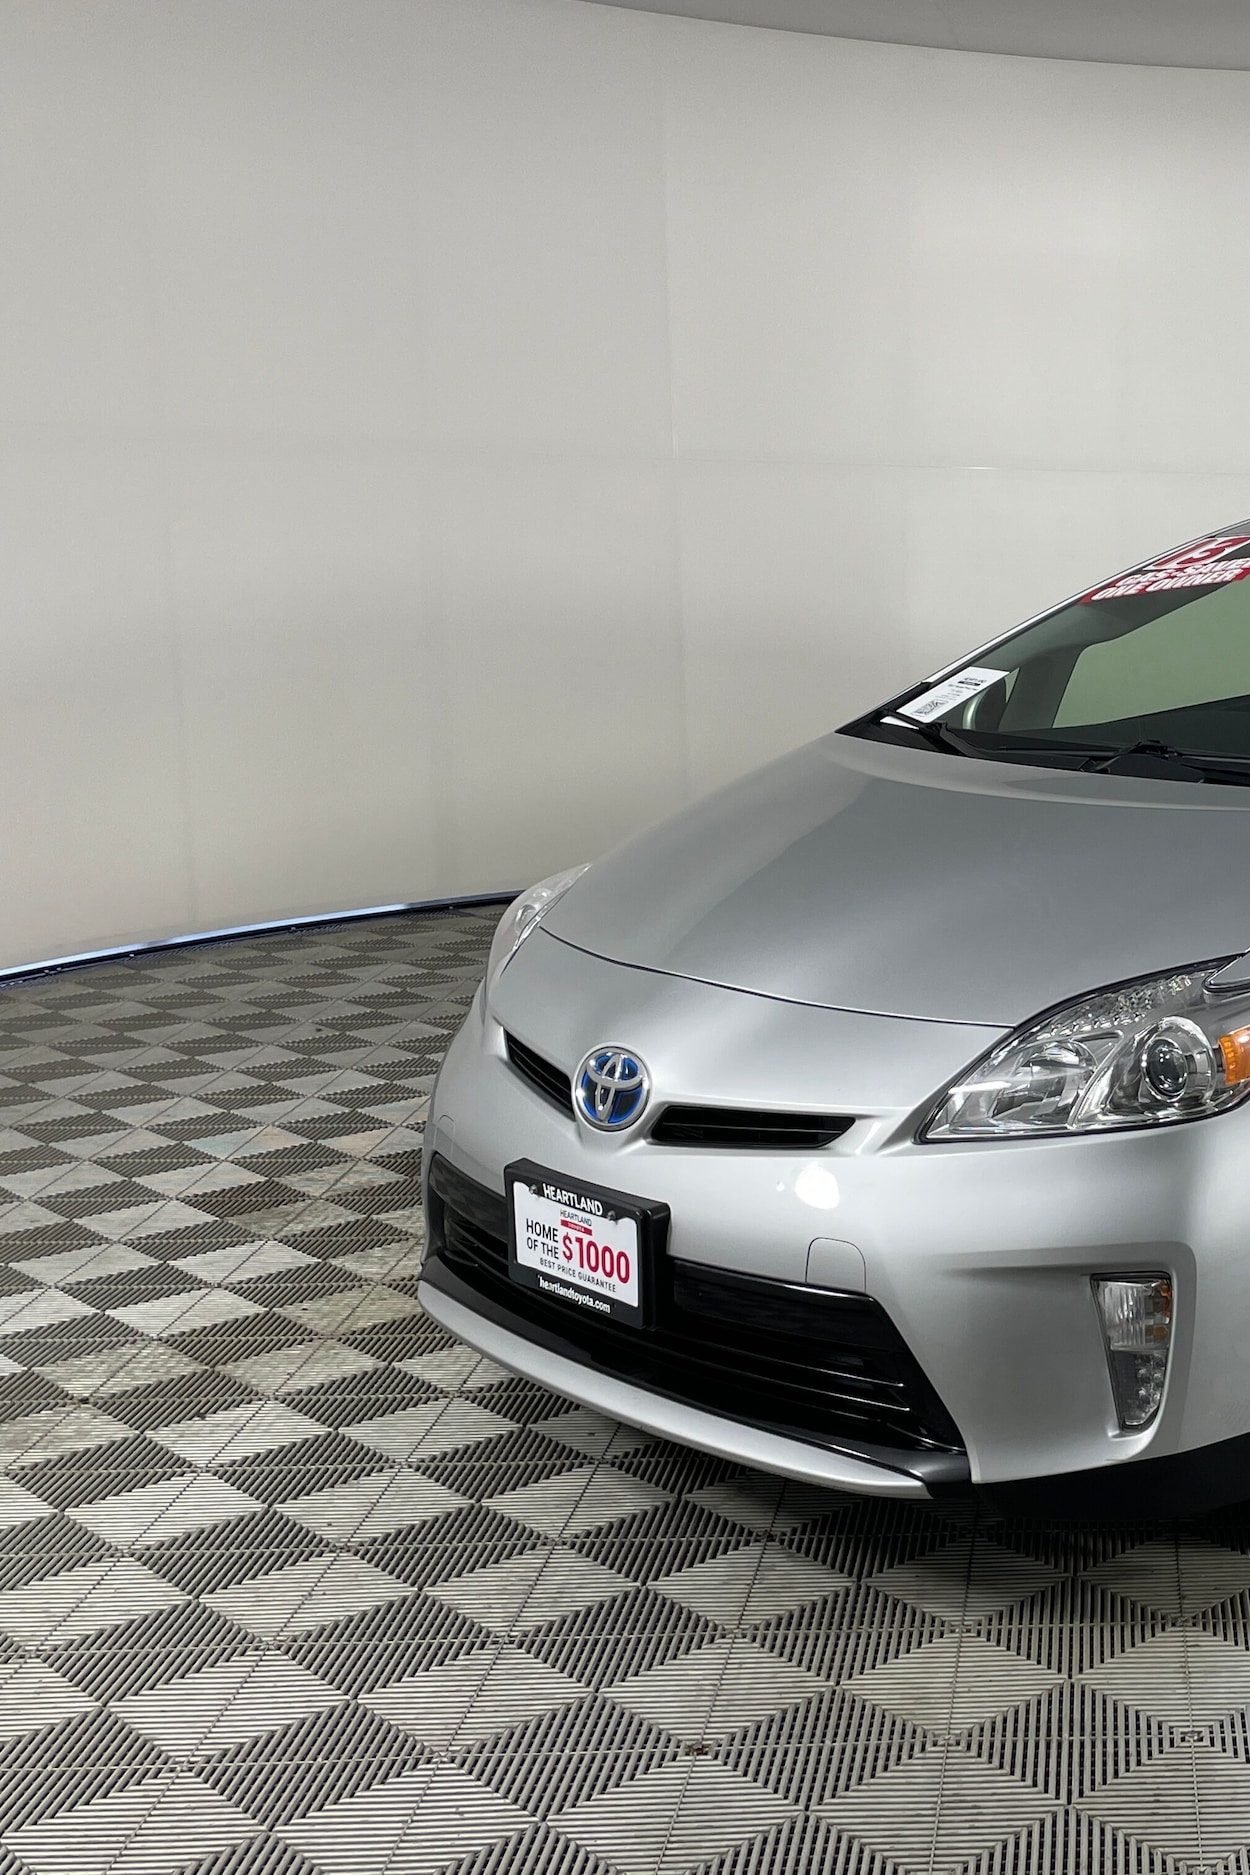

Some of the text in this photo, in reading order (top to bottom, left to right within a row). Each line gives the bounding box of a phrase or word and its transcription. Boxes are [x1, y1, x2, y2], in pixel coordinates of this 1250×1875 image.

[1091, 568, 1244, 601] ONE OWNER
[542, 1183, 603, 1216] HEARTLAND
[526, 1218, 559, 1243] HOME
[560, 1209, 592, 1227] HEARTLAND
[526, 1237, 559, 1260] OF THE
[562, 1232, 630, 1284] $1000
[539, 1258, 616, 1293] BEST PRICE GUARANTEE
[538, 1275, 611, 1314] heartlandtoyota.com
